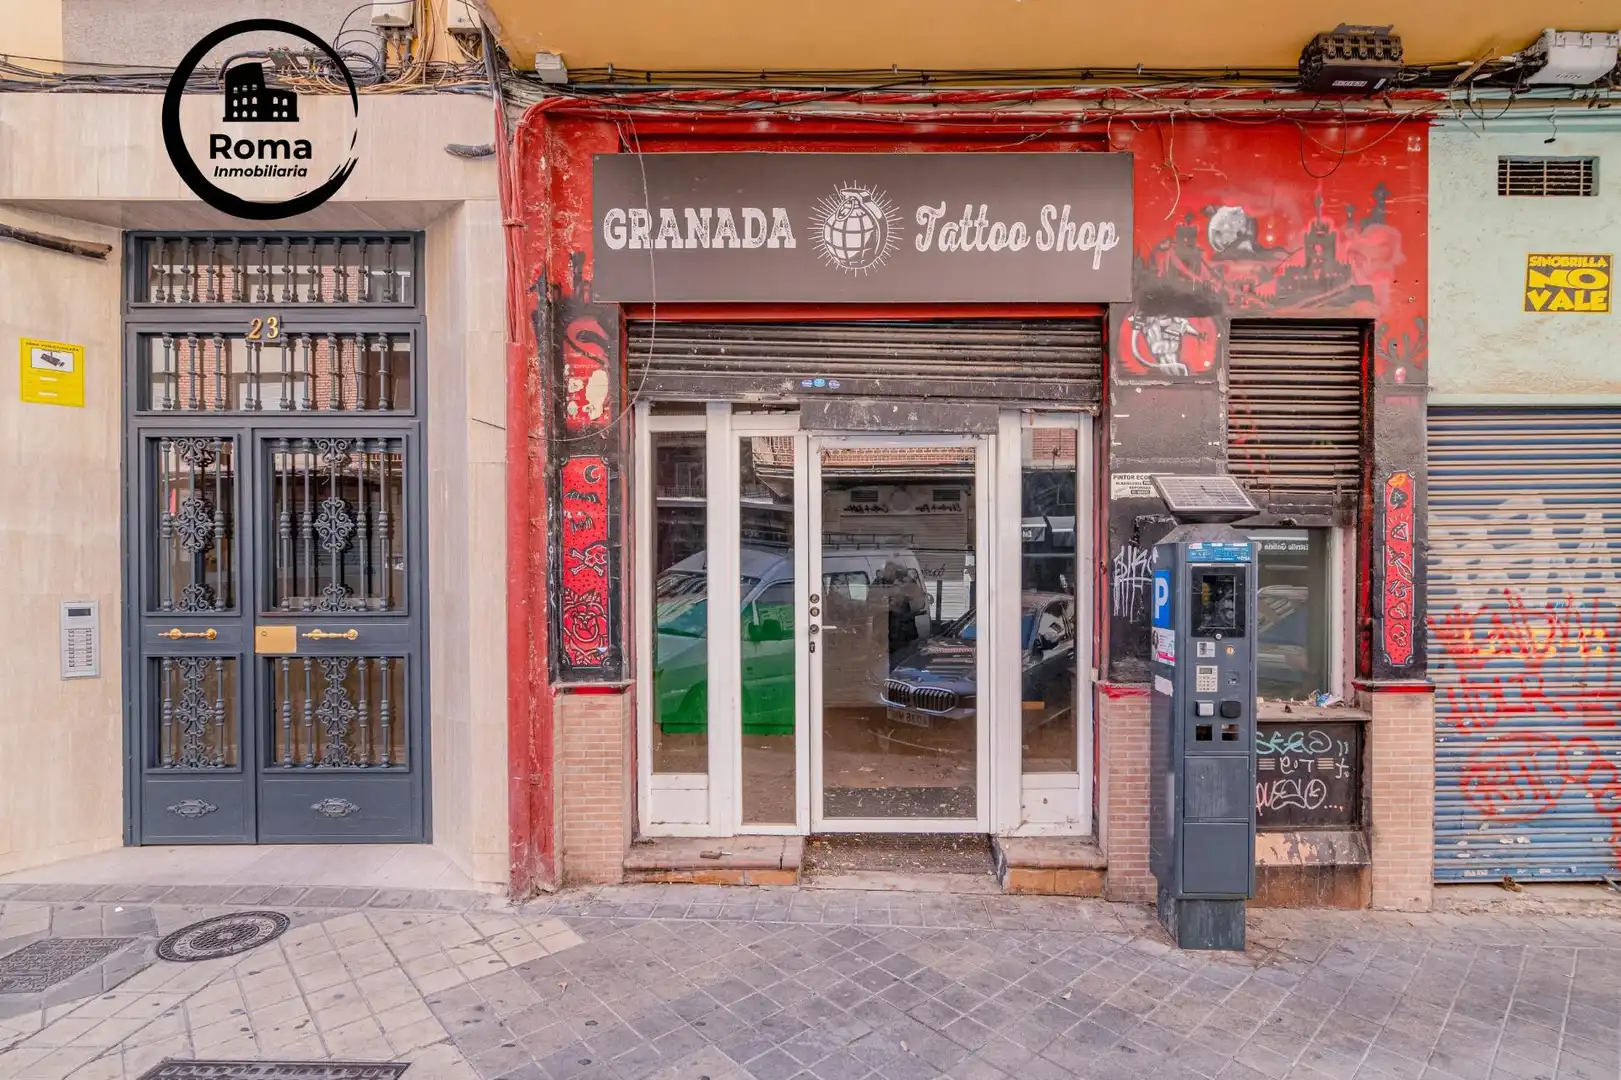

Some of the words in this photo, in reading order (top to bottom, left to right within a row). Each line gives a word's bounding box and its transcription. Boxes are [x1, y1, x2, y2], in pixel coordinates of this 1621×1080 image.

[603, 207, 797, 251] GRANADA
[915, 201, 1031, 253] Tattoo
[1035, 203, 1120, 270] Shop
[1529, 267, 1609, 290] NO
[1526, 289, 1608, 311] VALE
[248, 316, 279, 340] 23
[1155, 577, 1169, 619] P
